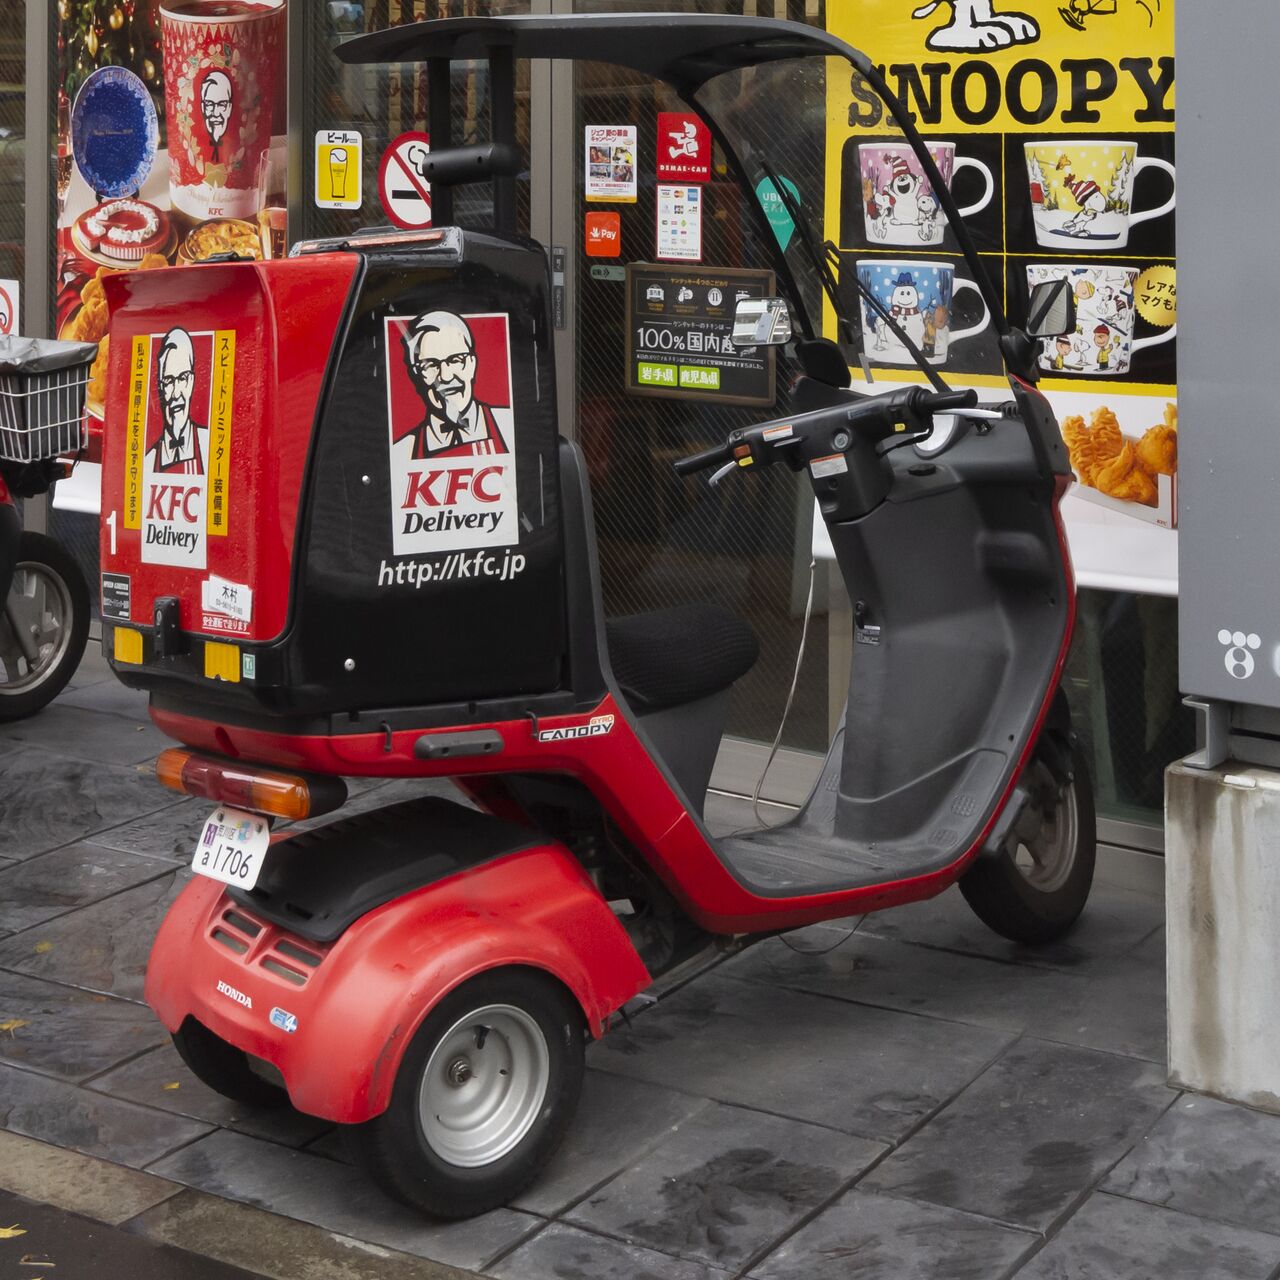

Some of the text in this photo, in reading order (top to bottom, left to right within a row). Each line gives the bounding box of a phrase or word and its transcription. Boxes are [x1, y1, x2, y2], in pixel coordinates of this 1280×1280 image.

[847, 56, 1176, 129] SNOOPY
[327, 131, 350, 144] ビール
[207, 207, 224, 216] KFC
[600, 229, 617, 241] Pay
[1146, 279, 1177, 297] レアな
[641, 367, 674, 382] 岩手県
[681, 370, 718, 386] 鹿児島県
[212, 337, 230, 528] スピードリミッター装備車
[400, 465, 505, 509] KFC
[145, 483, 202, 524] KFC
[106, 510, 117, 555] 1
[401, 509, 504, 535] Delivery
[145, 523, 199, 554] Delivery
[377, 548, 526, 589] http://kfc.jp
[540, 722, 613, 741] CANOPY
[590, 715, 614, 725] GYRO
[212, 844, 253, 879] 1706
[216, 979, 253, 1009] HONDA
